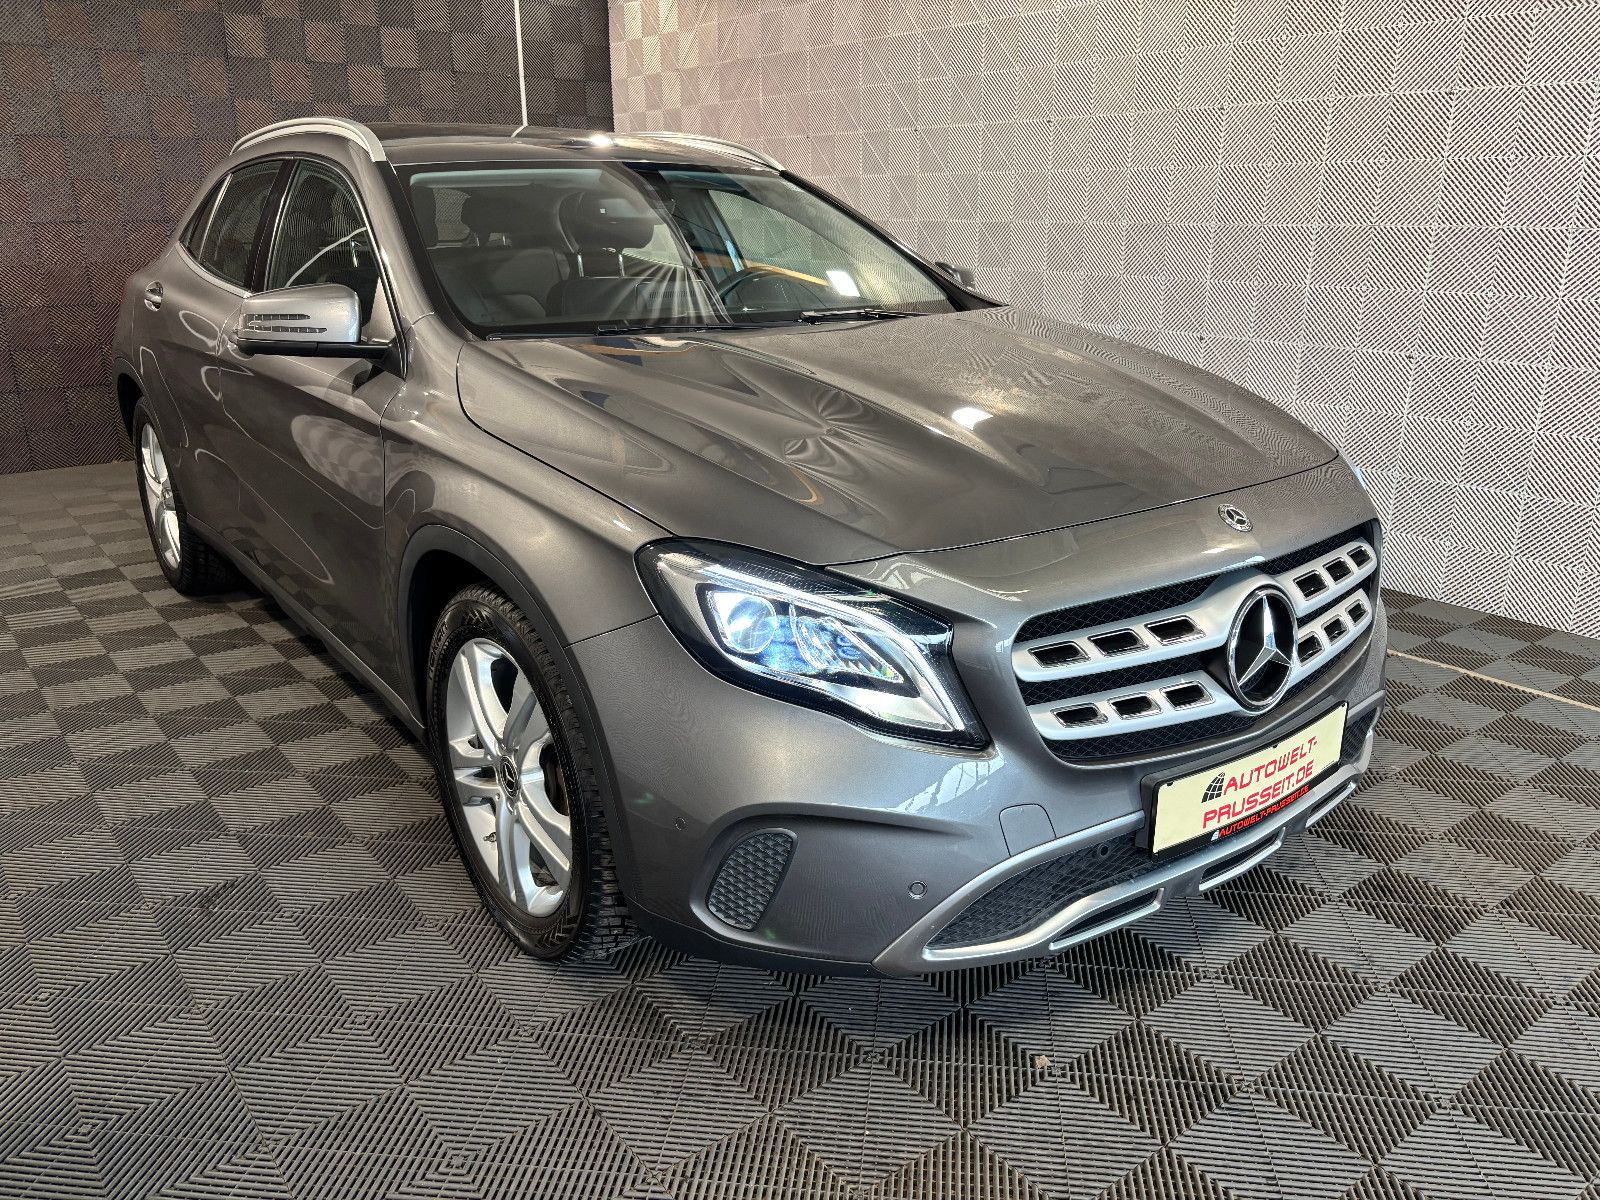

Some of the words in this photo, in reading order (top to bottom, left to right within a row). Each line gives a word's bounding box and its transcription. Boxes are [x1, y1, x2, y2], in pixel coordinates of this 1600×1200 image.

[1203, 759, 1315, 829] PRUSSEIT.DE
[1224, 735, 1318, 796] AUTOWELT-
[1218, 784, 1310, 838] AUTOWELT-PRUSSEIT.DE
